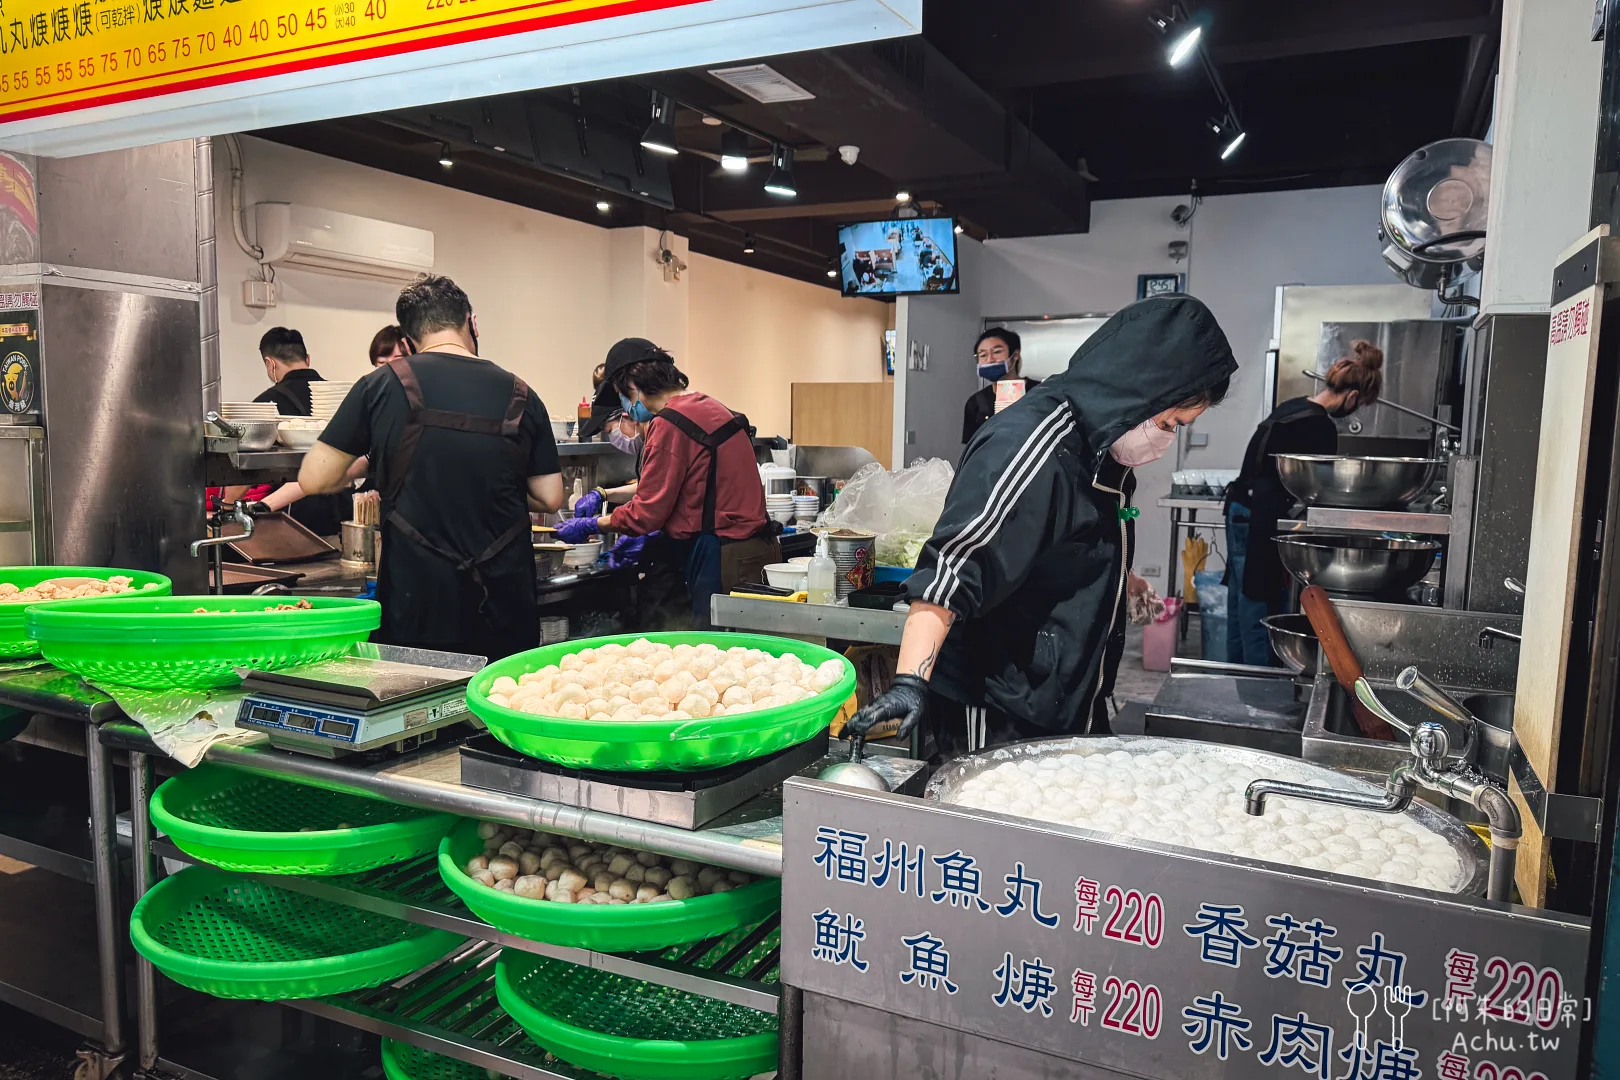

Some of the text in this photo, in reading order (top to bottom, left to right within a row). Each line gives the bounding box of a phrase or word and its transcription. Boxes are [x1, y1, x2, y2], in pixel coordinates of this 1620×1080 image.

[0, 0, 387, 92] 5 55 55 55 55 75 70 65 75 70 40 40 50 45 40
[813, 826, 1059, 930] 福州魚丸
[1074, 876, 1101, 935] 每斤
[1103, 886, 1165, 949] 220
[1183, 901, 1428, 1008] 香菇丸
[1484, 956, 1563, 1030] 220
[1070, 968, 1097, 1027] 每斤
[1101, 976, 1163, 1040] 220
